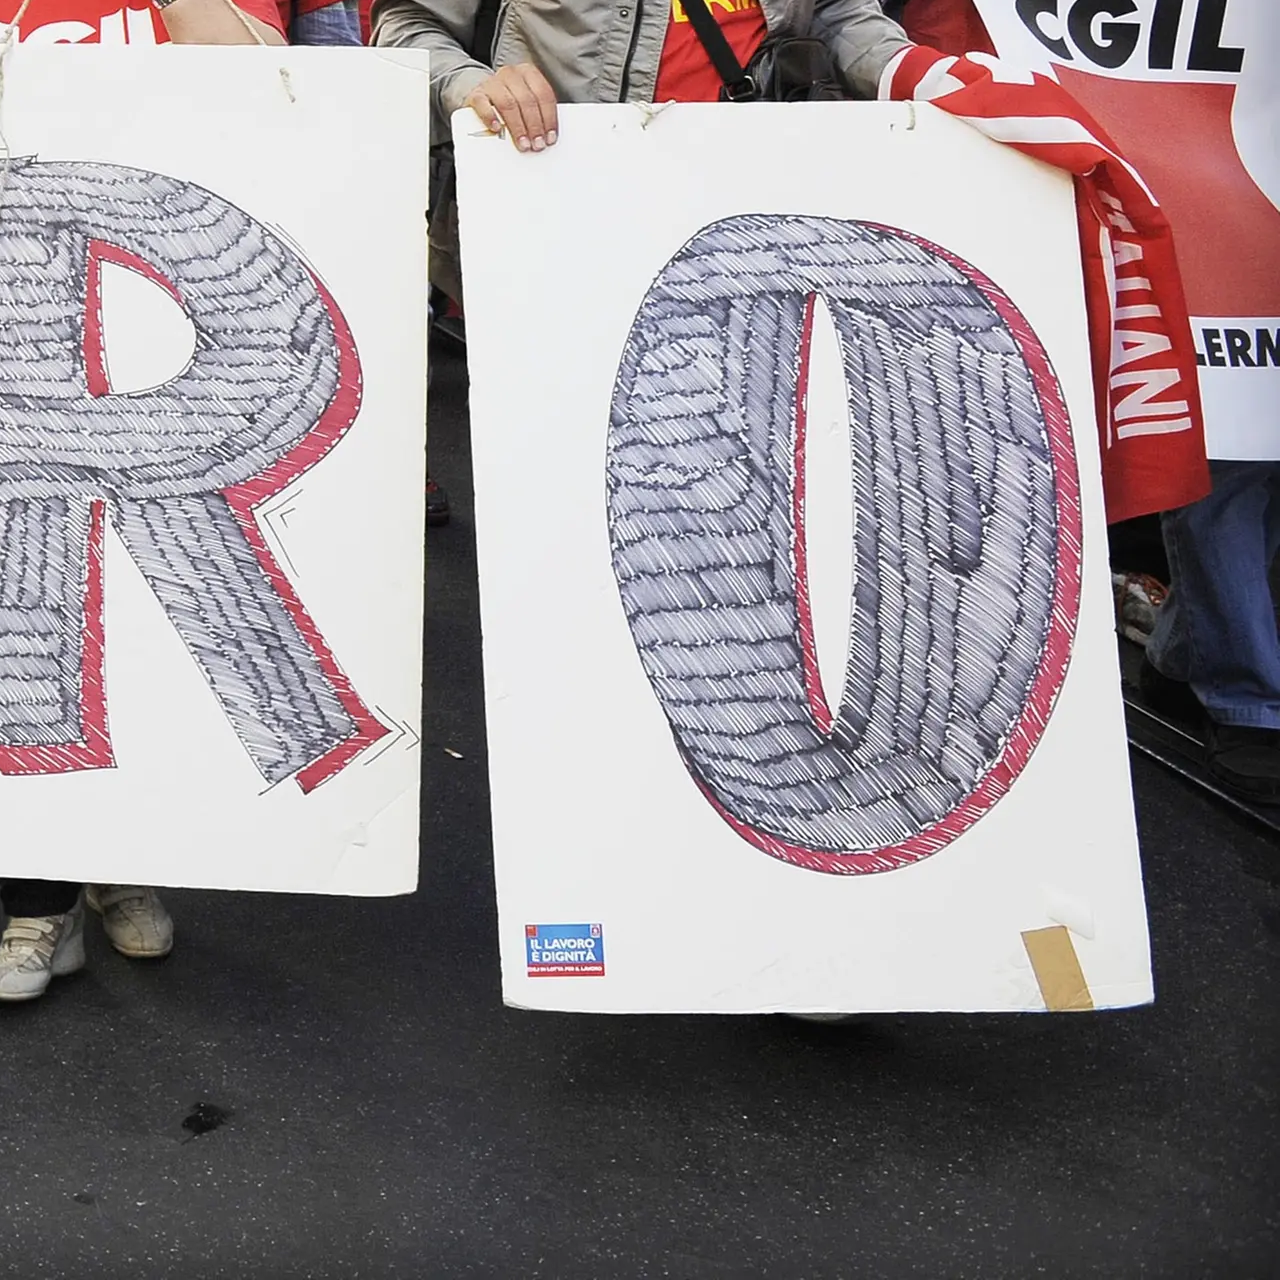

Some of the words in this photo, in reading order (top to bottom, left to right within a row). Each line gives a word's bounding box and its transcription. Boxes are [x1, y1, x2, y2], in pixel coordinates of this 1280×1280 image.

[606, 211, 1084, 876] O
[530, 938, 542, 950] IL
[544, 938, 596, 950] LAVORO
[531, 948, 540, 962] È
[542, 949, 597, 962] DIGNITÀ
